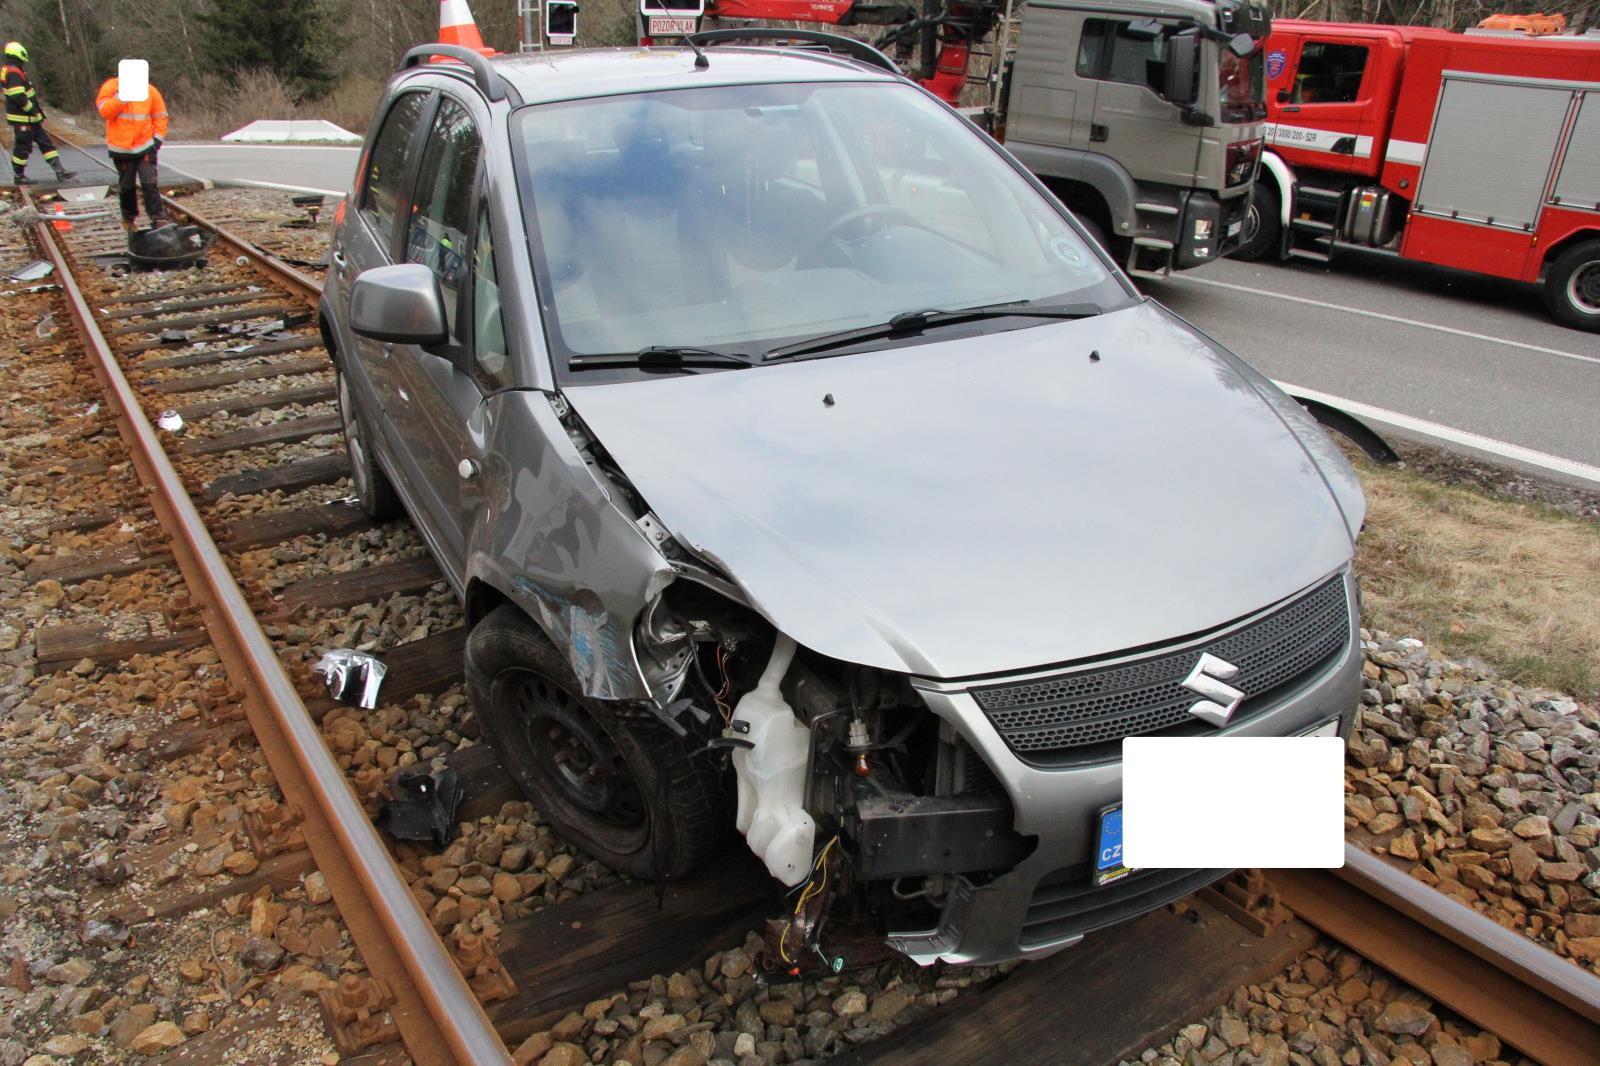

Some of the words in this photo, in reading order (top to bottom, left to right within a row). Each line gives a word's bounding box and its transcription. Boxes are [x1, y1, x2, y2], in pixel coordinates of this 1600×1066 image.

[652, 20, 675, 32] POZOR
[677, 20, 694, 32] VLAK
[1101, 844, 1122, 861] CZ
